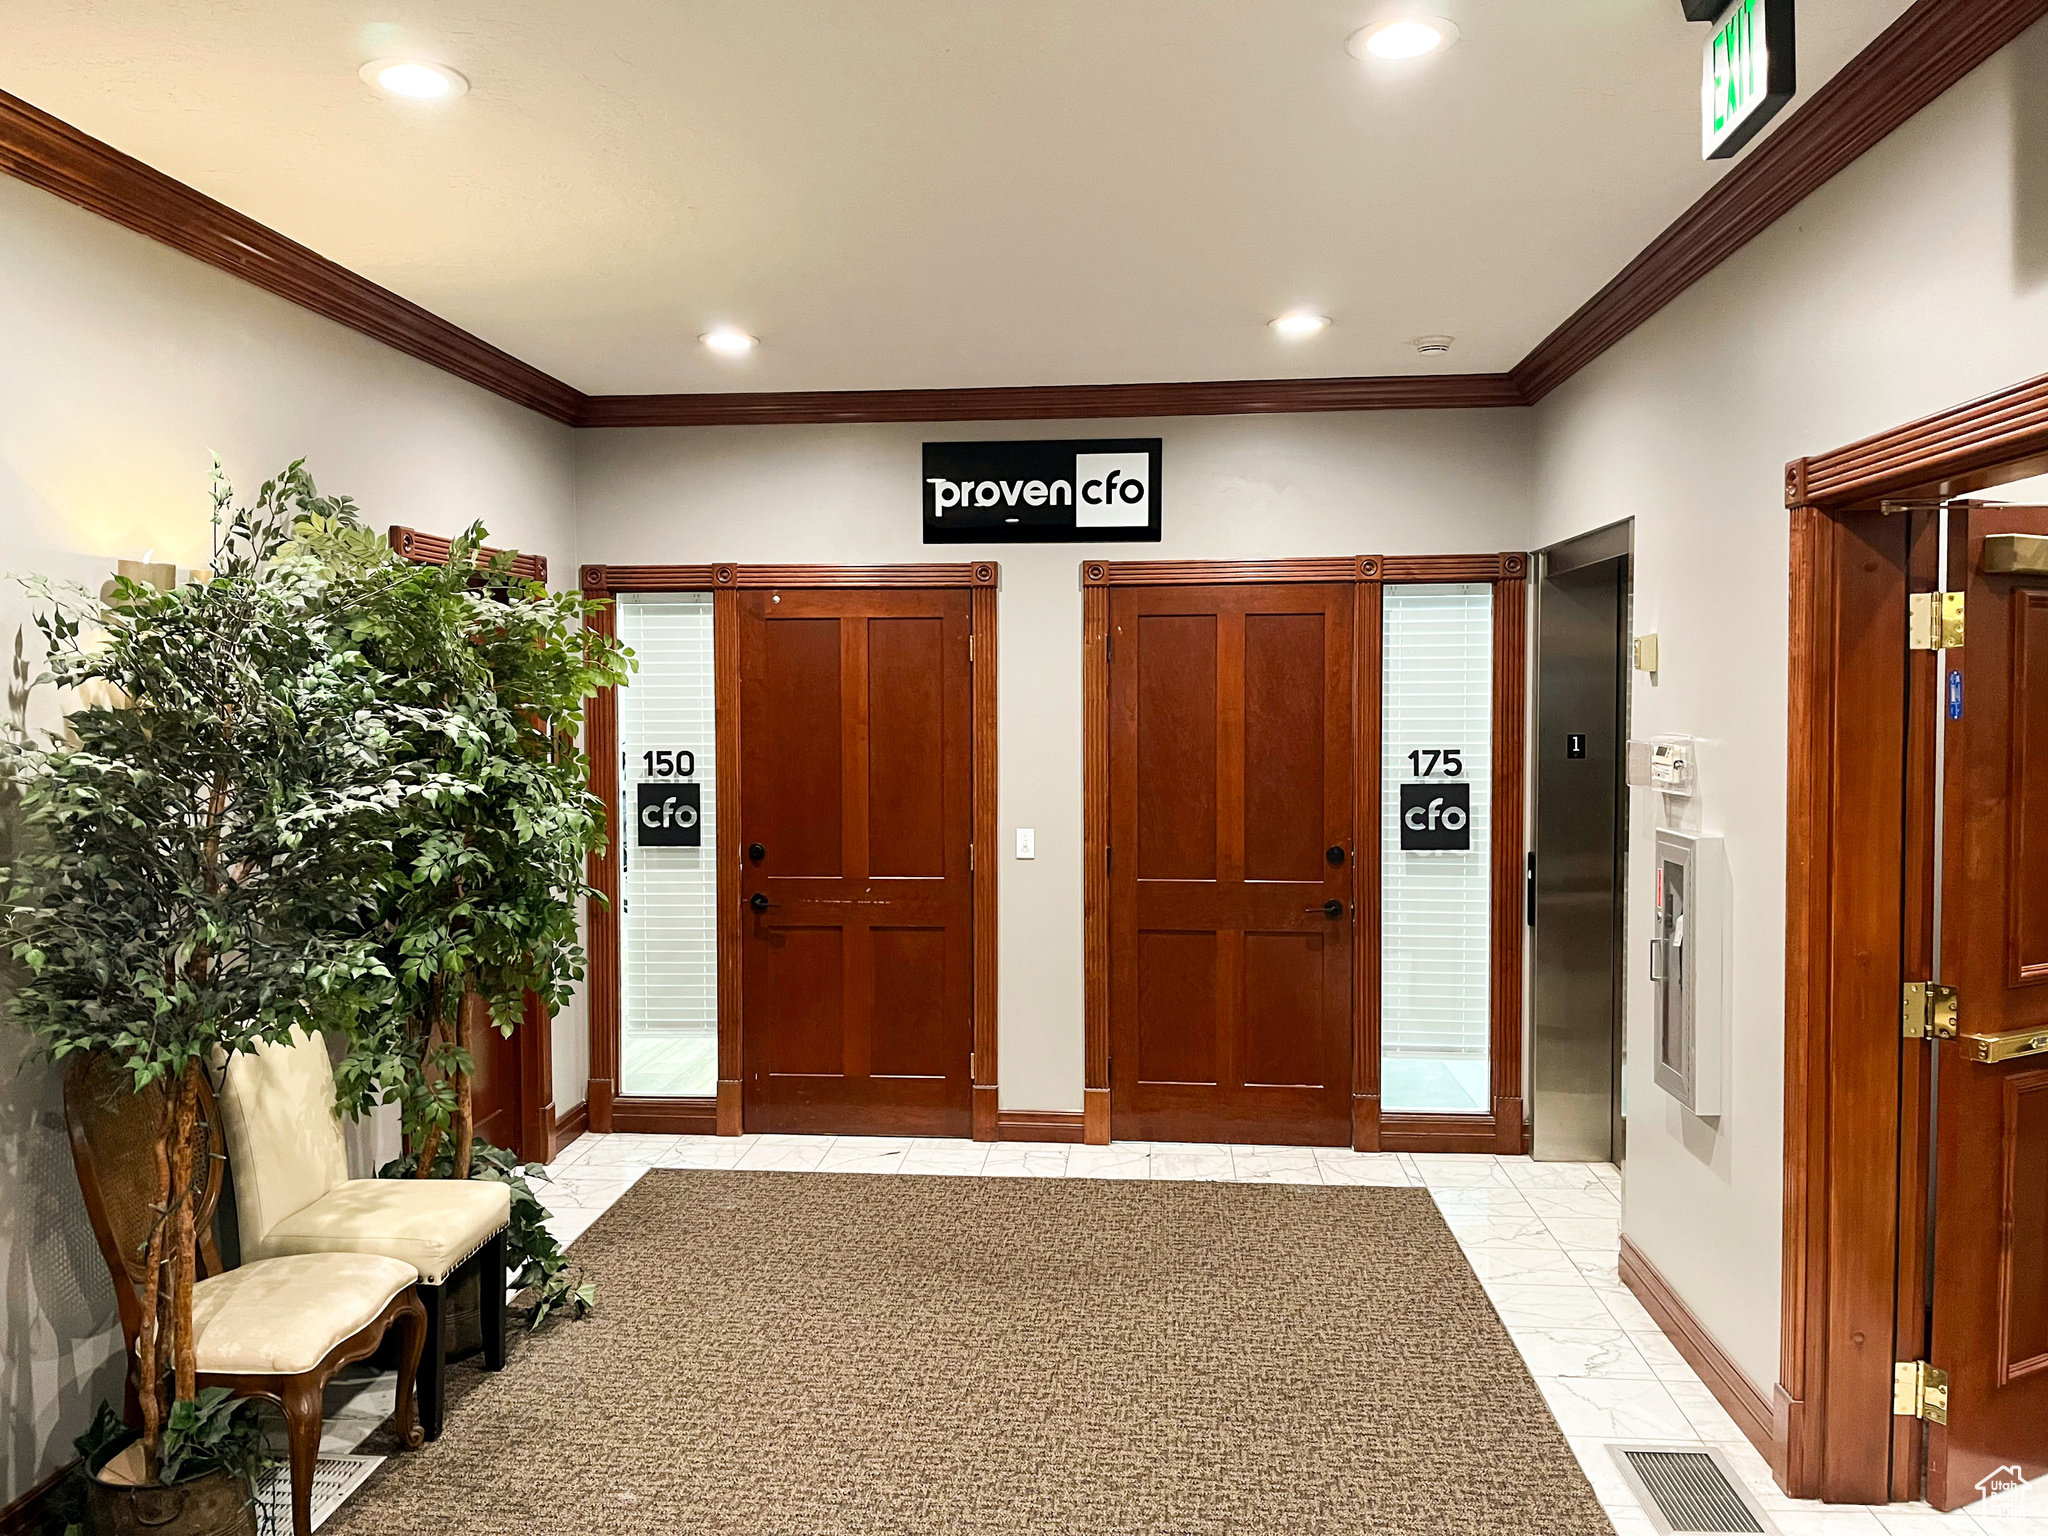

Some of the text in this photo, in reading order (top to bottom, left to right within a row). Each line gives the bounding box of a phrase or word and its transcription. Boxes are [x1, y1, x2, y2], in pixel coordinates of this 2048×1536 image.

[1713, 0, 1756, 134] EXIT
[934, 469, 1145, 517] proven cfo
[1572, 735, 1580, 752] 1
[643, 750, 695, 777] 150
[1408, 749, 1462, 777] 175
[641, 796, 698, 829] cfo
[1404, 797, 1467, 831] cfo
